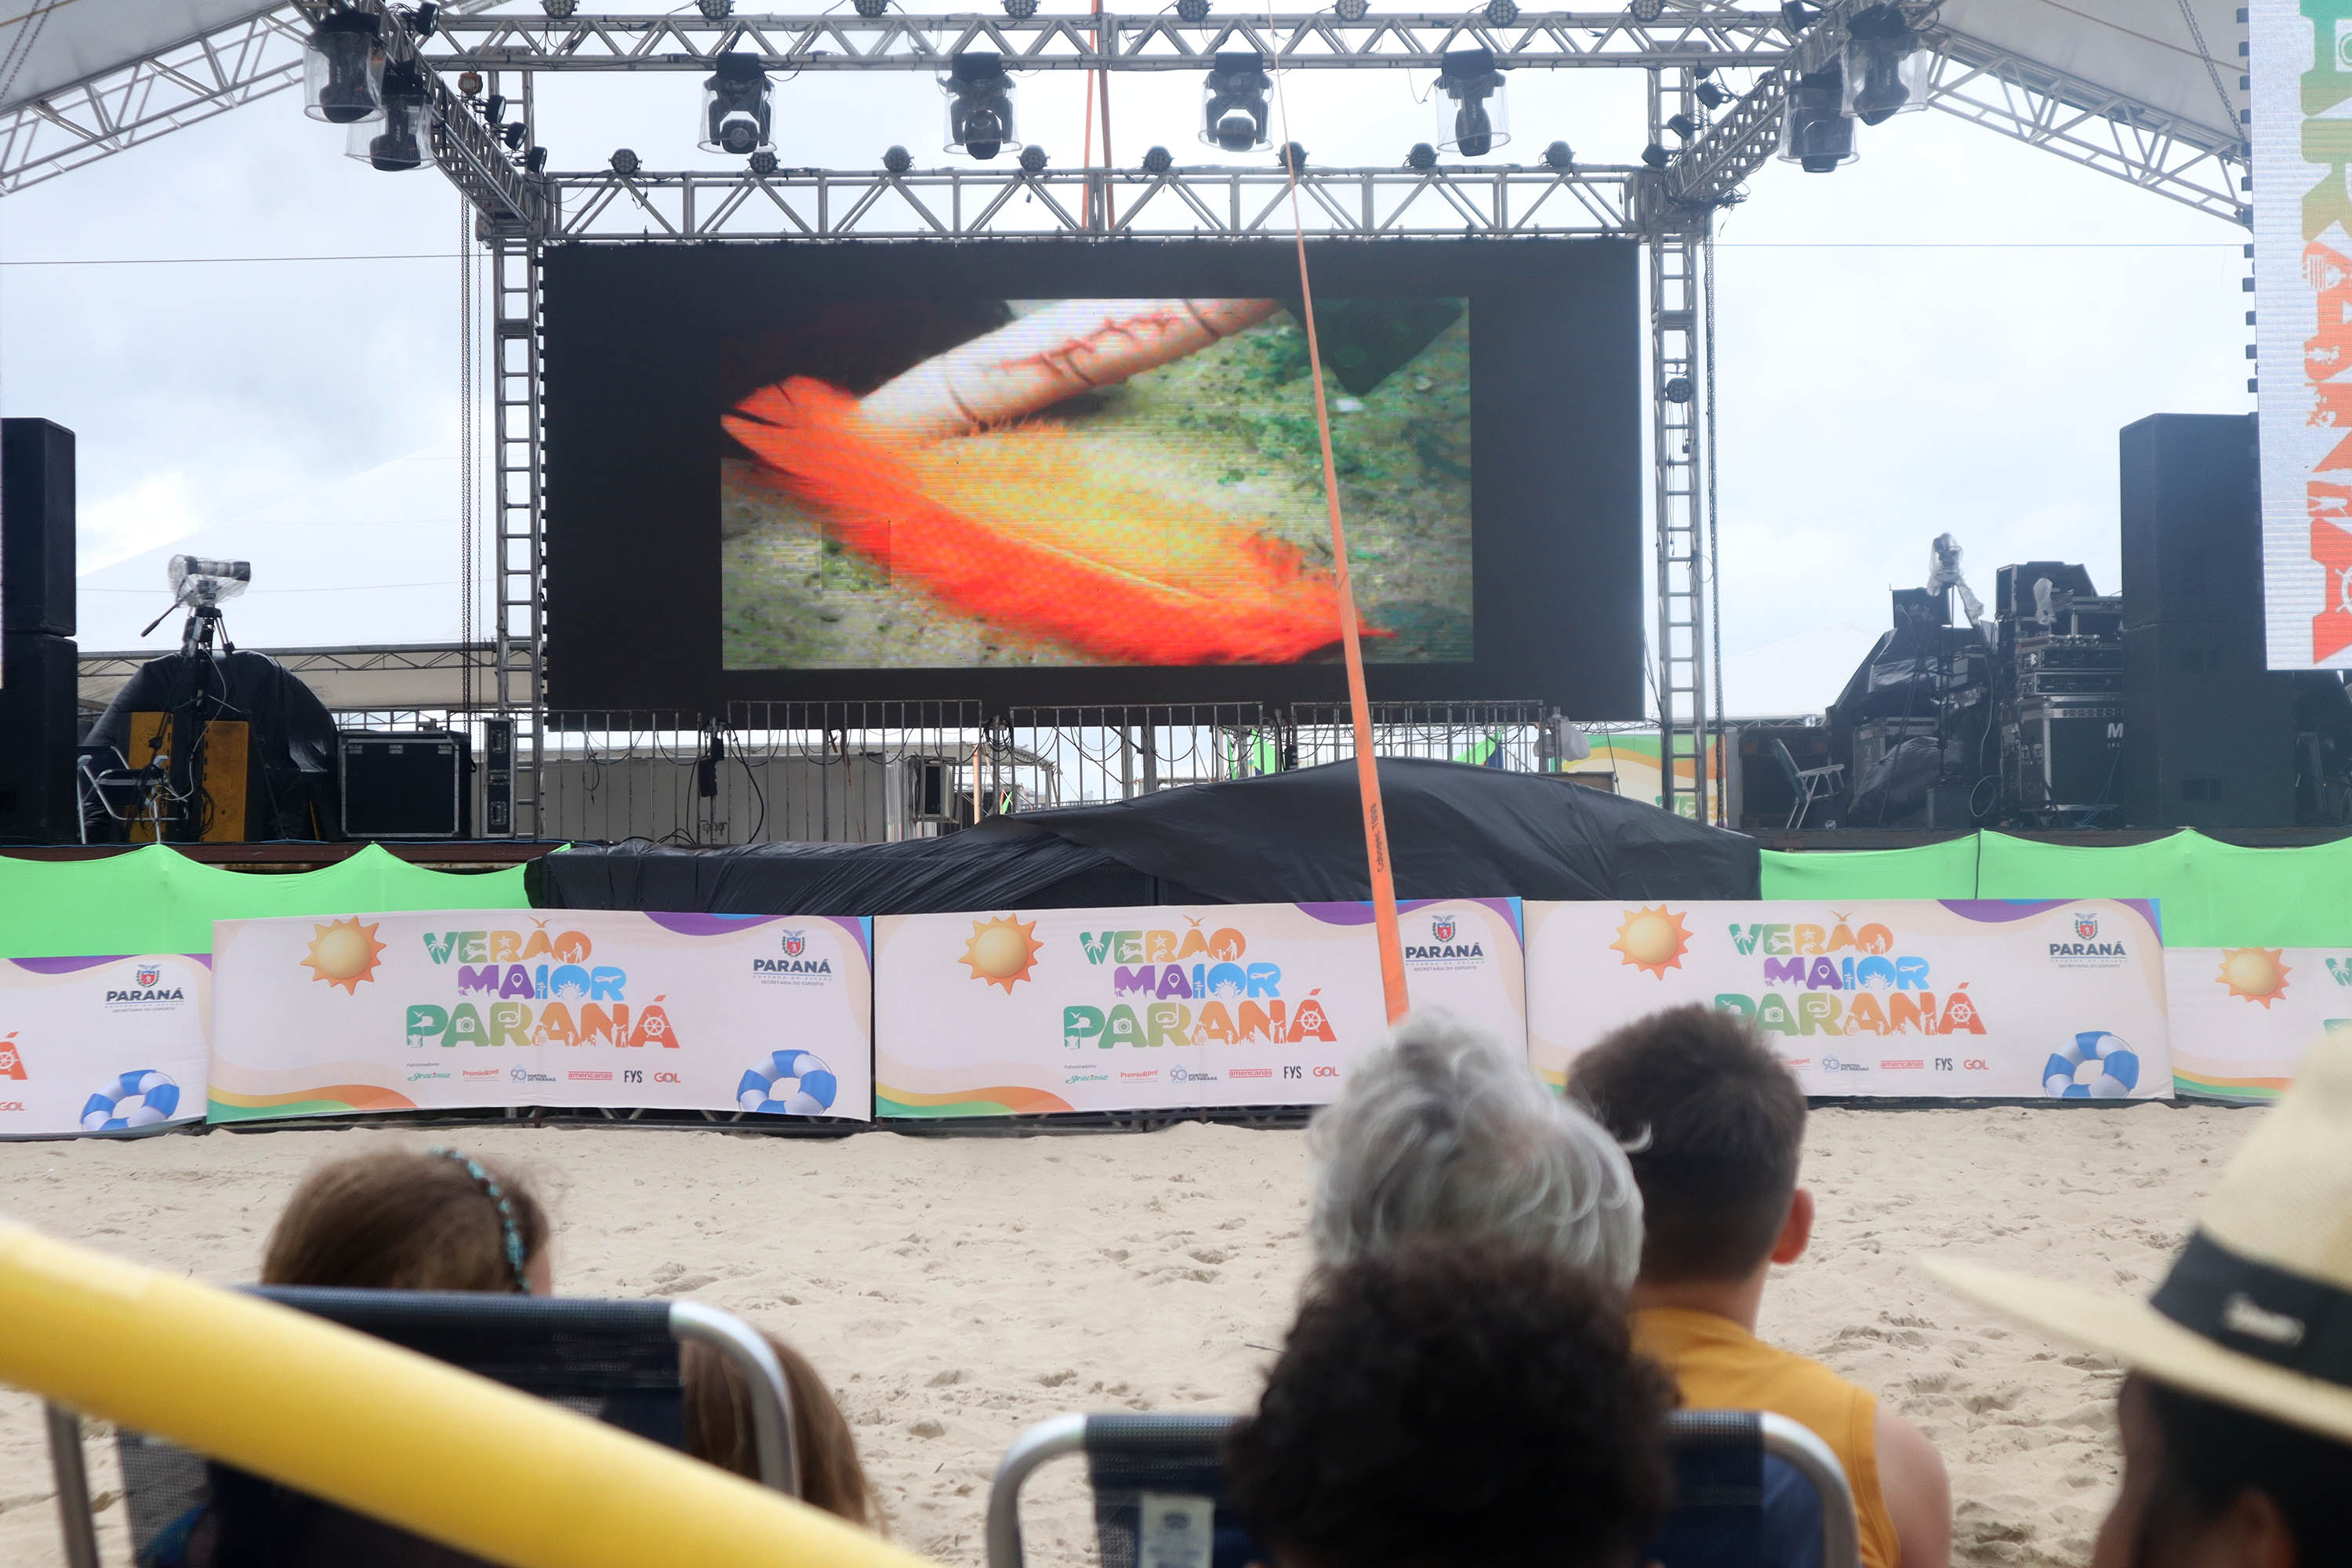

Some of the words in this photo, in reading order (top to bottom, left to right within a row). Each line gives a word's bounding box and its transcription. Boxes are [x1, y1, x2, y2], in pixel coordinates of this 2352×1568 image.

[423, 916, 592, 964] VERÃO
[1080, 914, 1246, 965] VERÃO
[1729, 910, 1894, 955] VERÃO
[1405, 942, 1483, 958] PARANÁ
[2049, 941, 2126, 956] PARANÁ
[753, 959, 831, 973] PARANÁ
[1764, 956, 1930, 990] MAIOR
[458, 964, 626, 1001] MAIOR
[1114, 963, 1281, 1000] MAIOR
[106, 987, 184, 1002] PARANÁ
[406, 994, 680, 1047] PARANÁ
[1063, 988, 1338, 1049] PARANÁ
[1312, 1066, 1340, 1077] GOL
[1935, 1058, 1953, 1071] FYS
[1964, 1060, 1989, 1070] GOL
[624, 1070, 643, 1083] FYS
[654, 1073, 681, 1083] GOL
[1283, 1066, 1302, 1079] FYS
